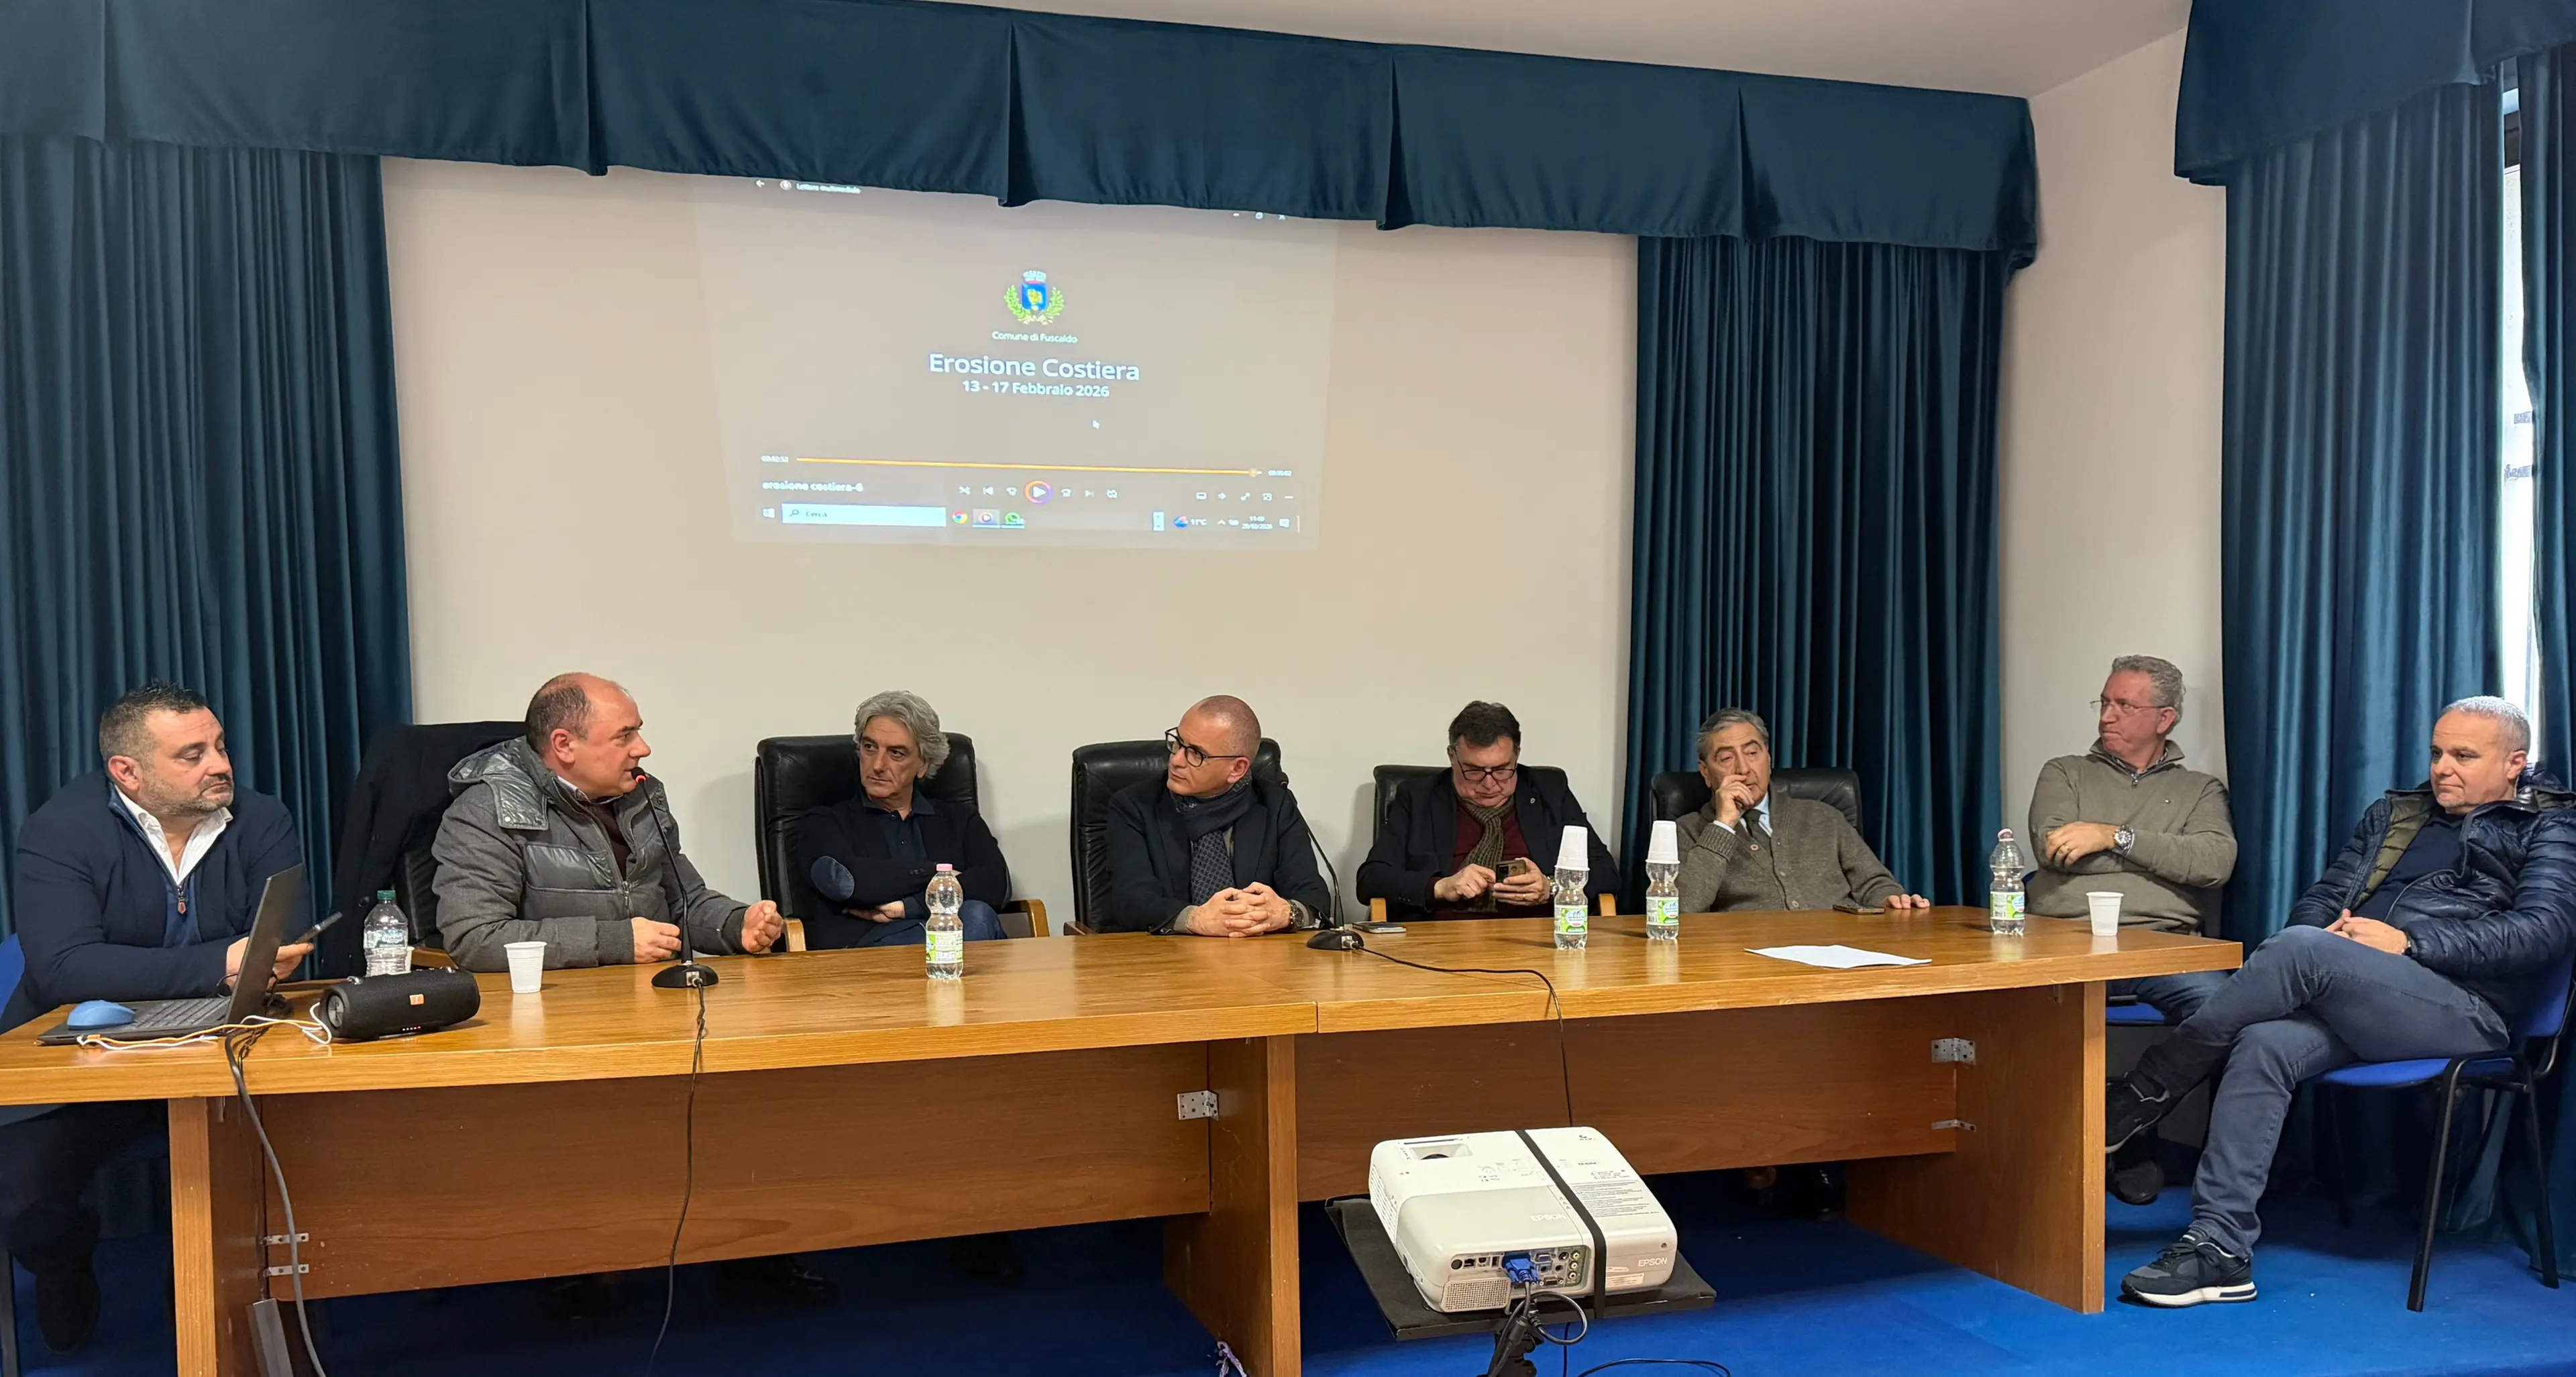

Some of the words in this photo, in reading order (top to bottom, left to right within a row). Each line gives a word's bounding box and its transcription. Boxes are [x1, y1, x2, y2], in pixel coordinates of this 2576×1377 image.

[991, 331, 1028, 341] Comune
[1030, 332, 1039, 341] di
[1040, 333, 1078, 343] Fuscaldo
[929, 353, 1036, 376] Erosione
[1042, 359, 1140, 381] Costiera
[963, 380, 981, 392] 13
[992, 381, 1009, 394] 17
[1012, 382, 1073, 396] Febbraio
[1075, 384, 1110, 397] 2026
[1530, 1213, 1566, 1221] EPSON
[1638, 1257, 1668, 1267] EPSON
